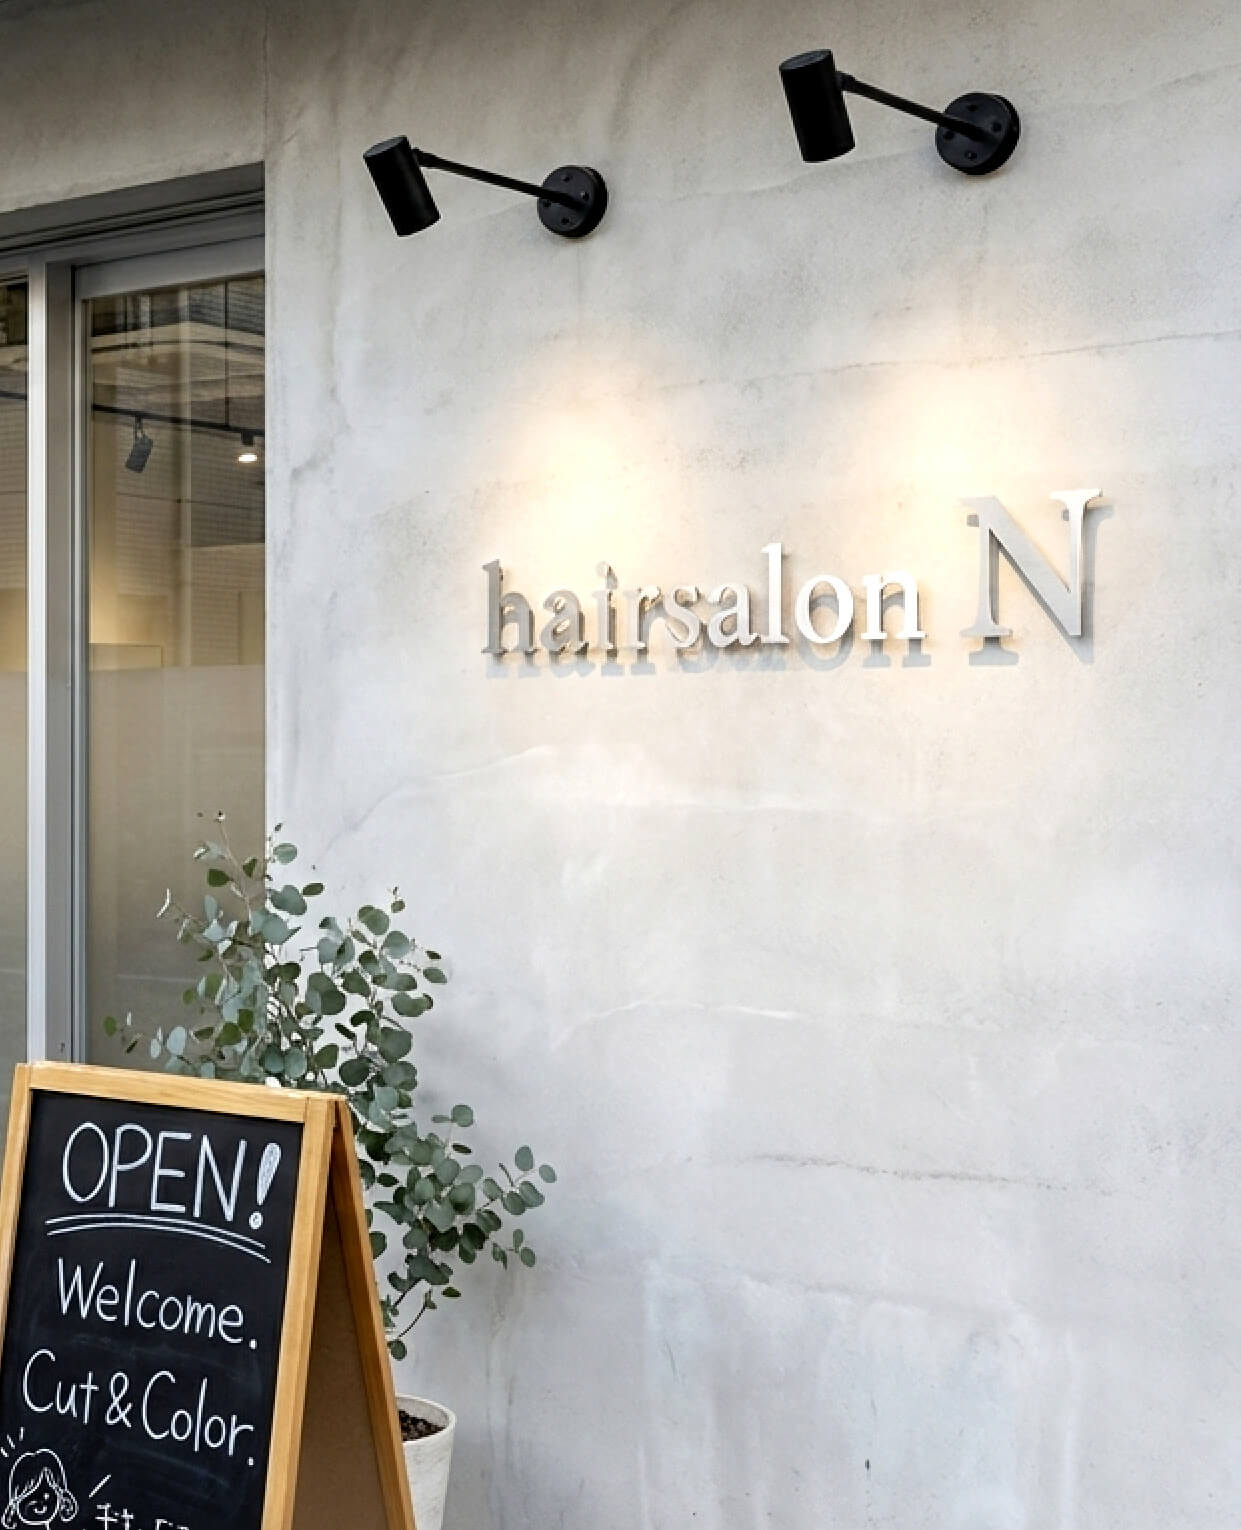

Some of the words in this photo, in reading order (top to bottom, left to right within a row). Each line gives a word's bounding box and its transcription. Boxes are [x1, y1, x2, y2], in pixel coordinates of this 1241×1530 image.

[480, 542, 926, 656] hairsalon
[960, 487, 1103, 639] N
[62, 1121, 283, 1230] OPEN!
[57, 1256, 258, 1350] Welcome.
